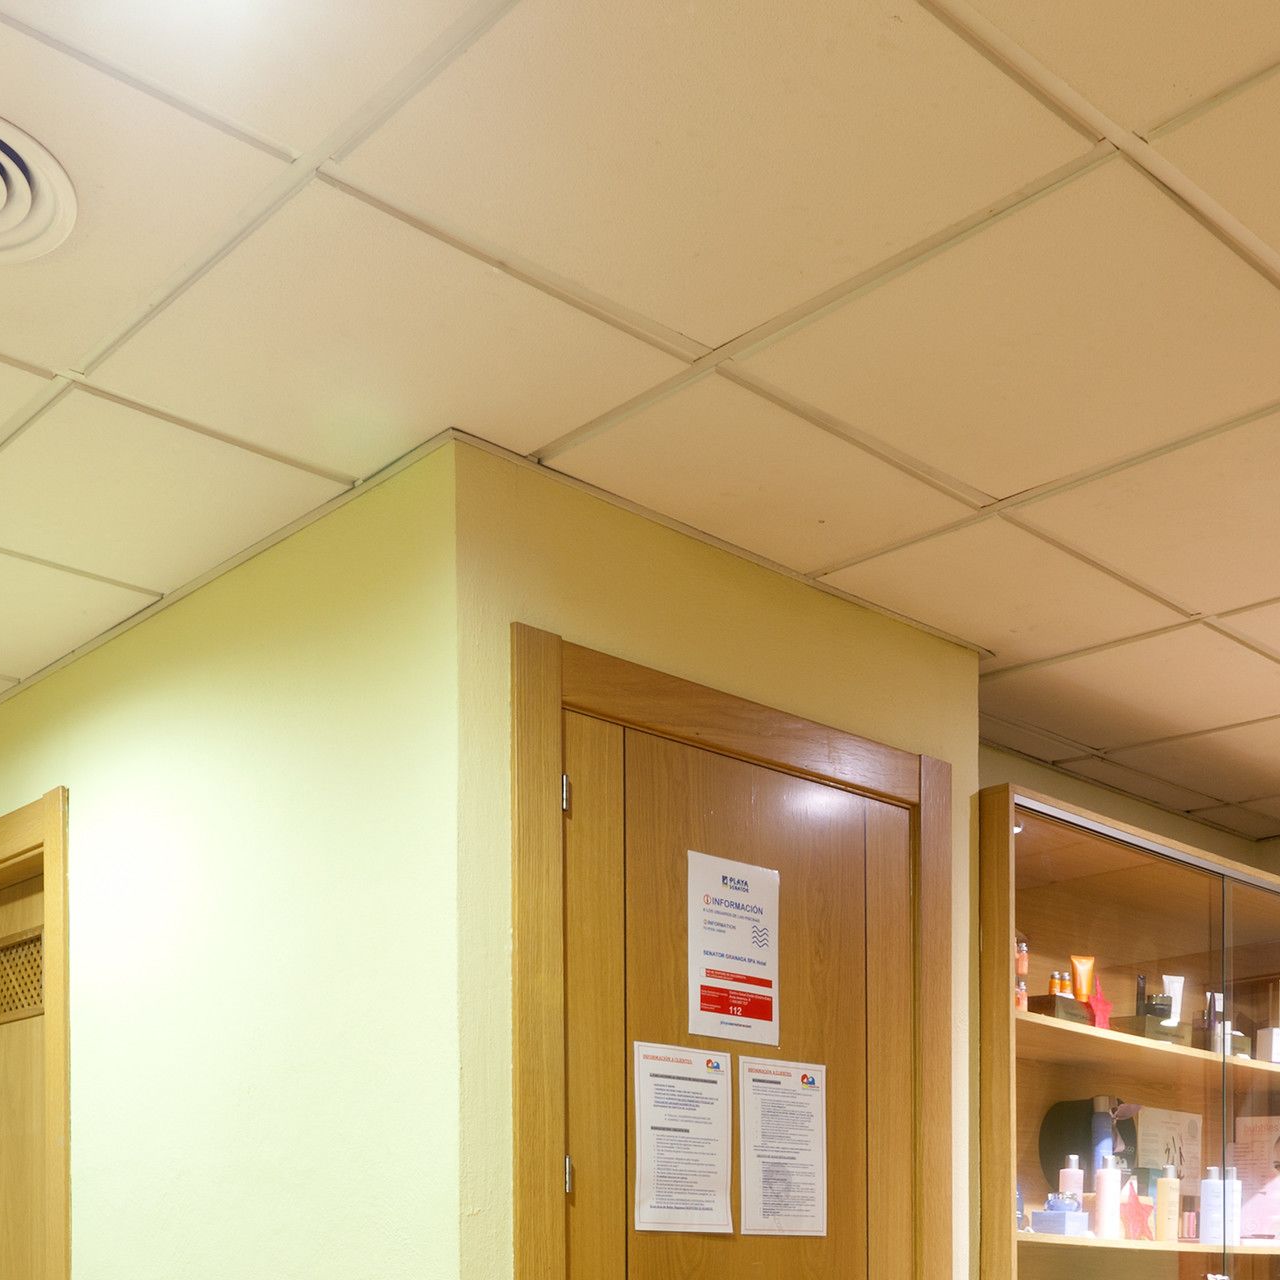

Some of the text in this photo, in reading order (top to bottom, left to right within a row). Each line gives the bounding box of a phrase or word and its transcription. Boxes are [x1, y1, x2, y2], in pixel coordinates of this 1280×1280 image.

[728, 876, 749, 887] PLAYA
[712, 897, 764, 915] INFORMACIÓN
[703, 949, 725, 958] SENATOR
[726, 953, 747, 963] GRANADA
[728, 1005, 743, 1016] 112
